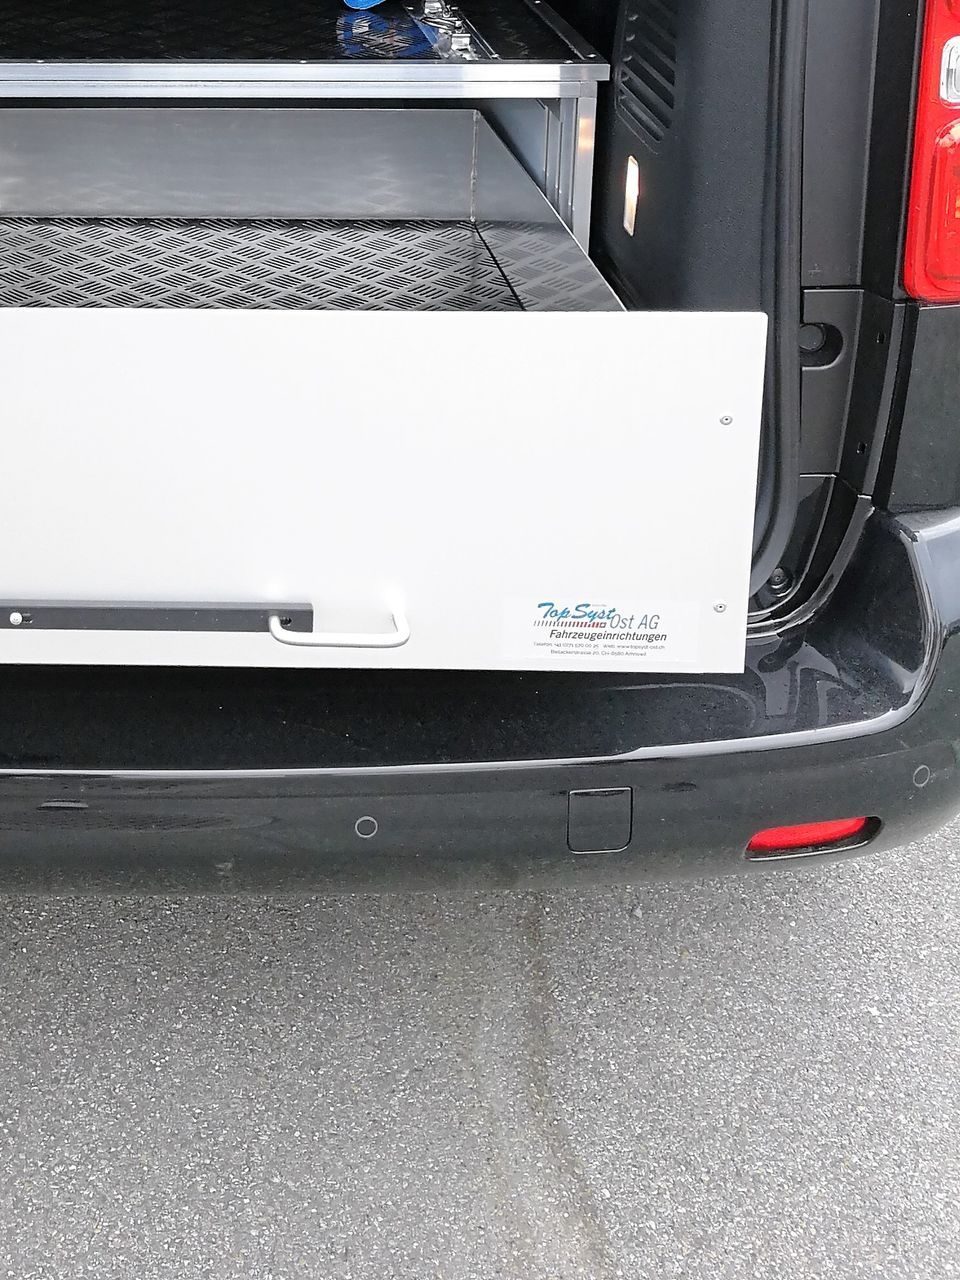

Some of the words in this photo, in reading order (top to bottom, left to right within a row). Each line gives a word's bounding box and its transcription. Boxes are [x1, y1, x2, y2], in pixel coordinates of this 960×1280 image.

[610, 613, 635, 630] Ost
[637, 614, 660, 630] AG
[549, 629, 668, 643] Fahrzeugeinrichtungen
